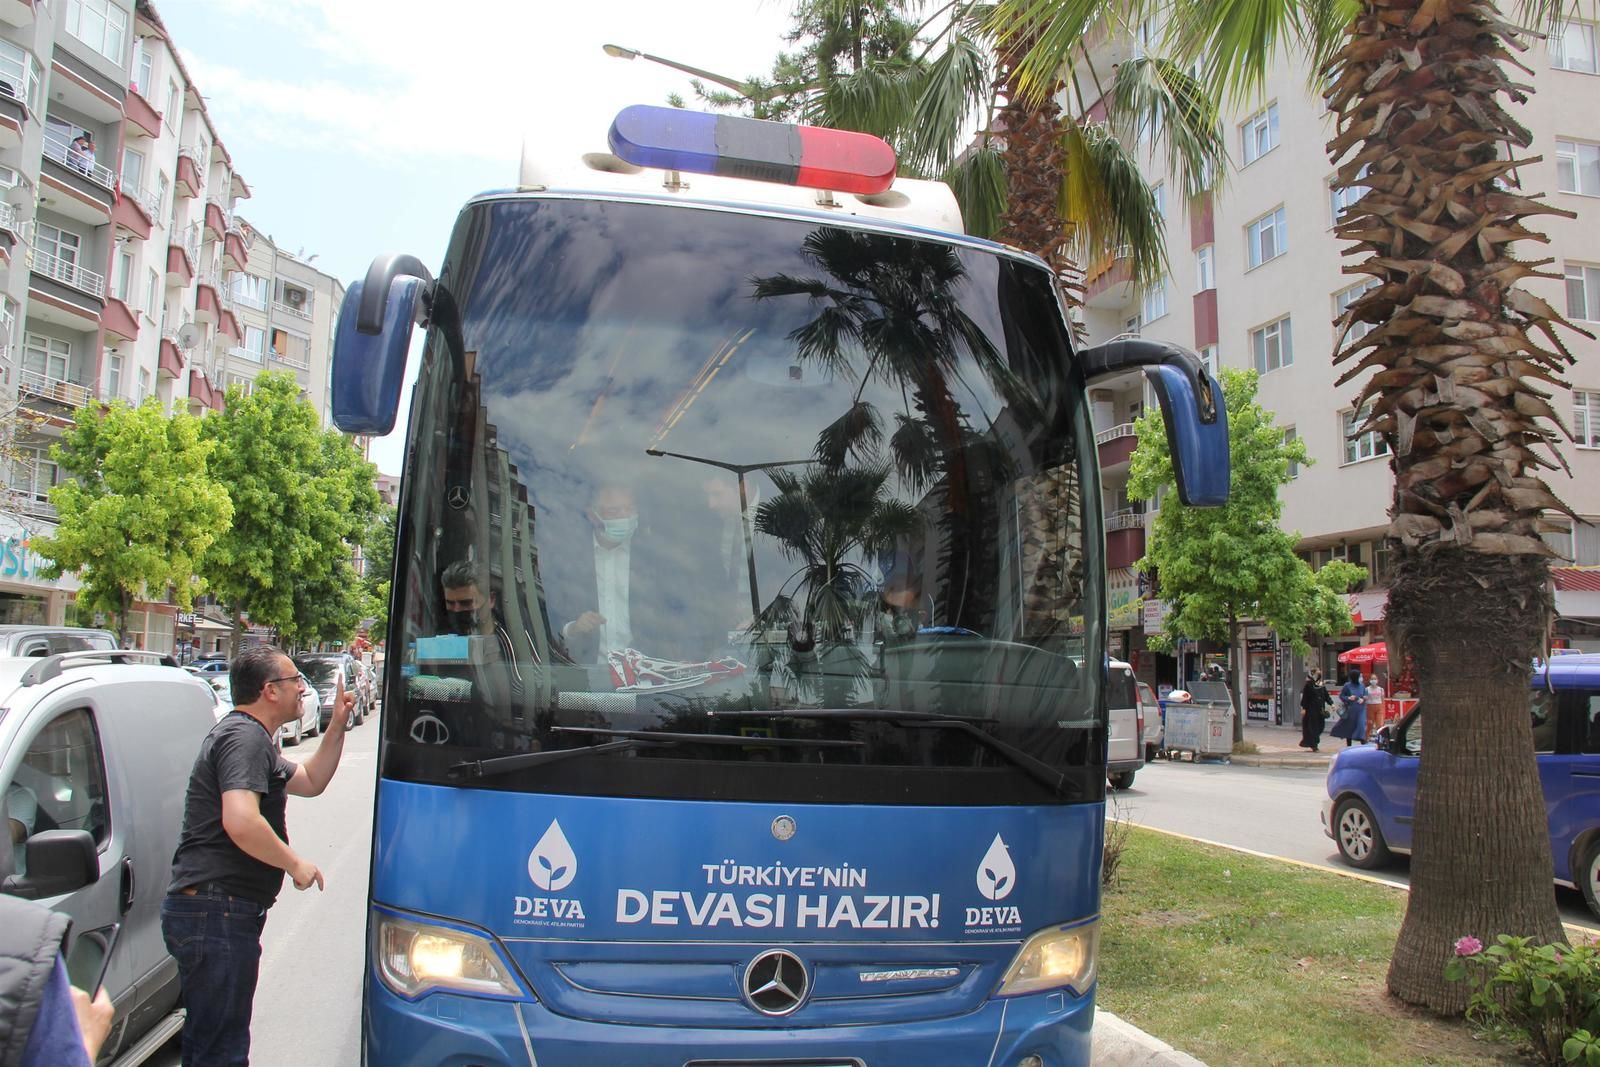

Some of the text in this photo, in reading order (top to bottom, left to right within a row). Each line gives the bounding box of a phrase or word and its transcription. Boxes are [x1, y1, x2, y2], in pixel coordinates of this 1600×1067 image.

[514, 896, 586, 919] DEVA
[616, 888, 940, 929] DEVASI HAZIR!
[965, 906, 1022, 926] DEVA
